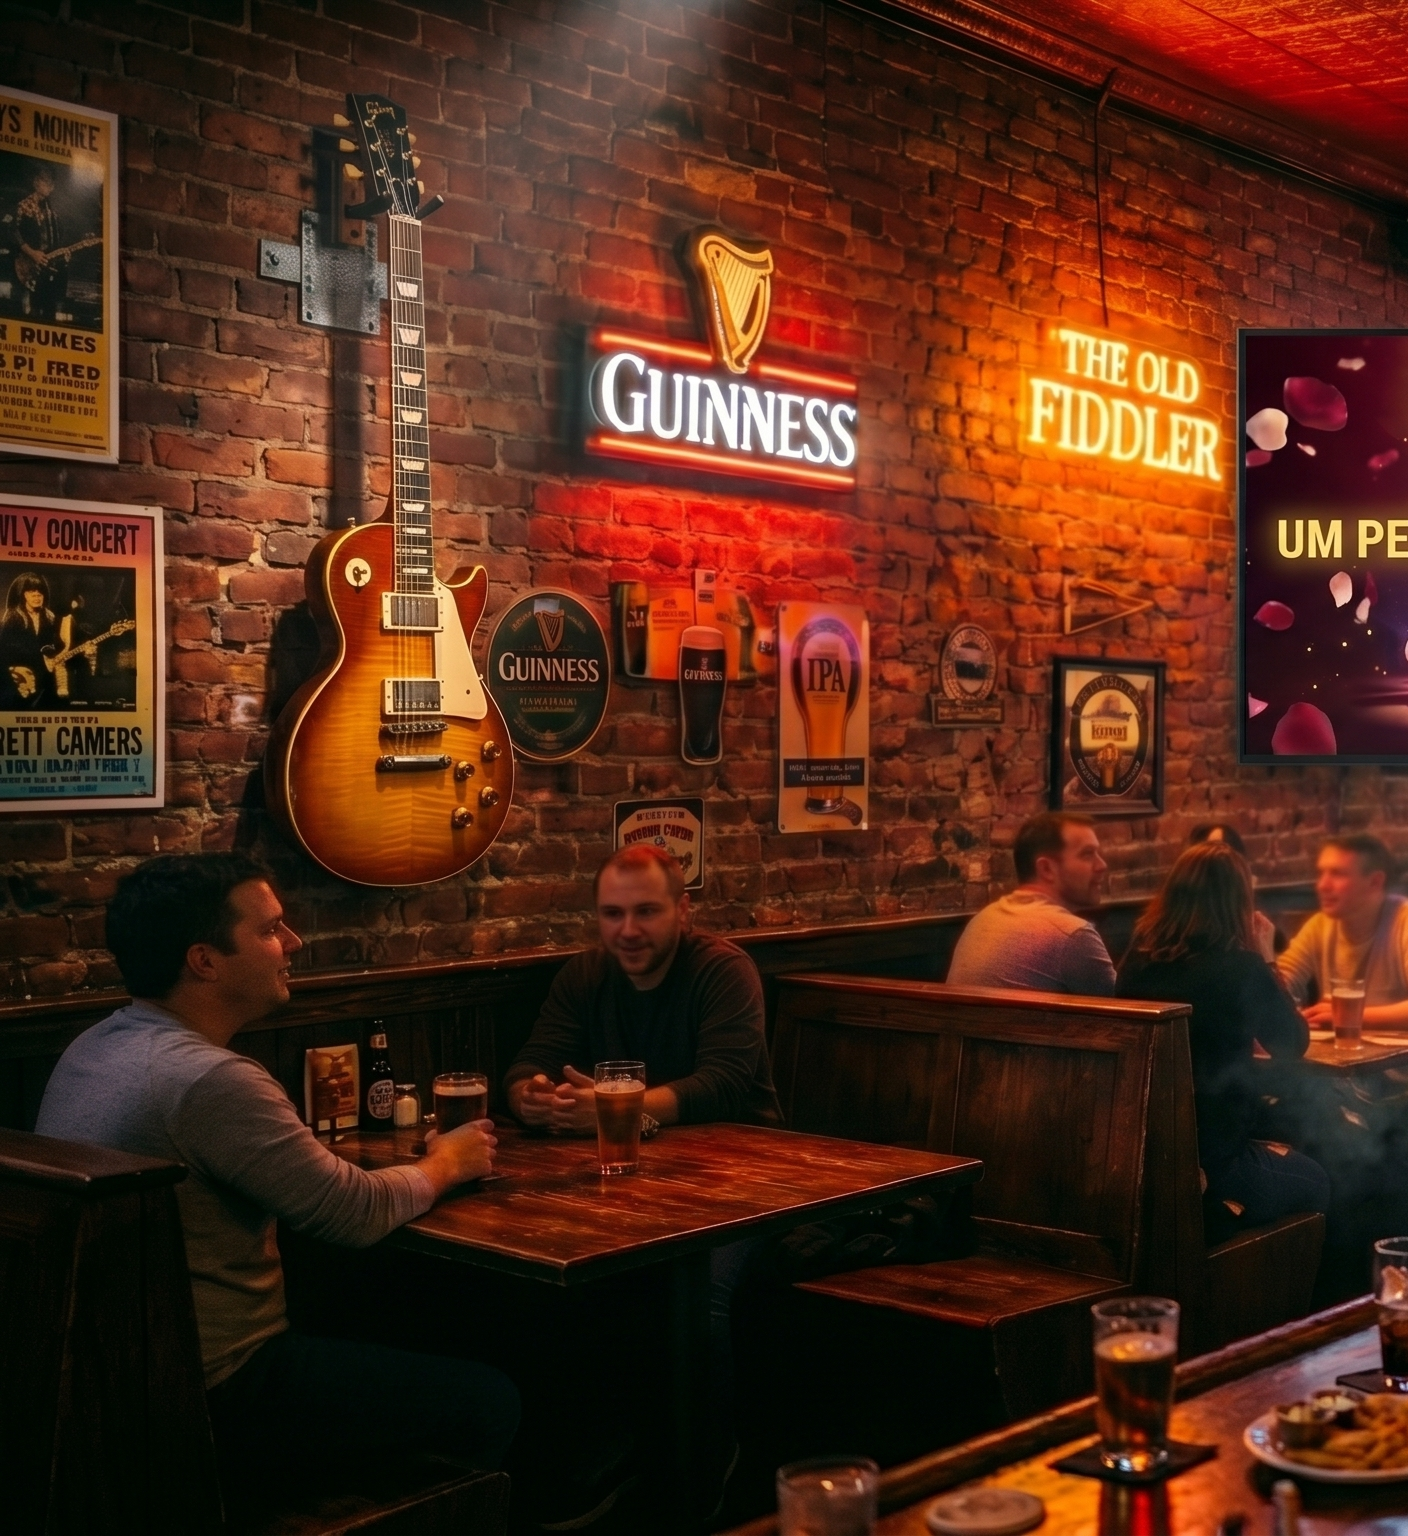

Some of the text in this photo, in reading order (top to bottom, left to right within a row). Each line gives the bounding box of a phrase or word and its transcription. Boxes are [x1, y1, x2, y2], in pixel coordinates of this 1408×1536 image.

[47, 360, 101, 381] FRED
[1058, 328, 1200, 404] THE OLD
[601, 352, 856, 467] GUINNESS
[1027, 377, 1223, 482] FIDDLER
[46, 517, 140, 556] CONCERT
[1277, 519, 1343, 559] UM
[498, 651, 600, 683] GUINNESS
[806, 658, 846, 693] IPA
[56, 726, 143, 756] CAMERS
